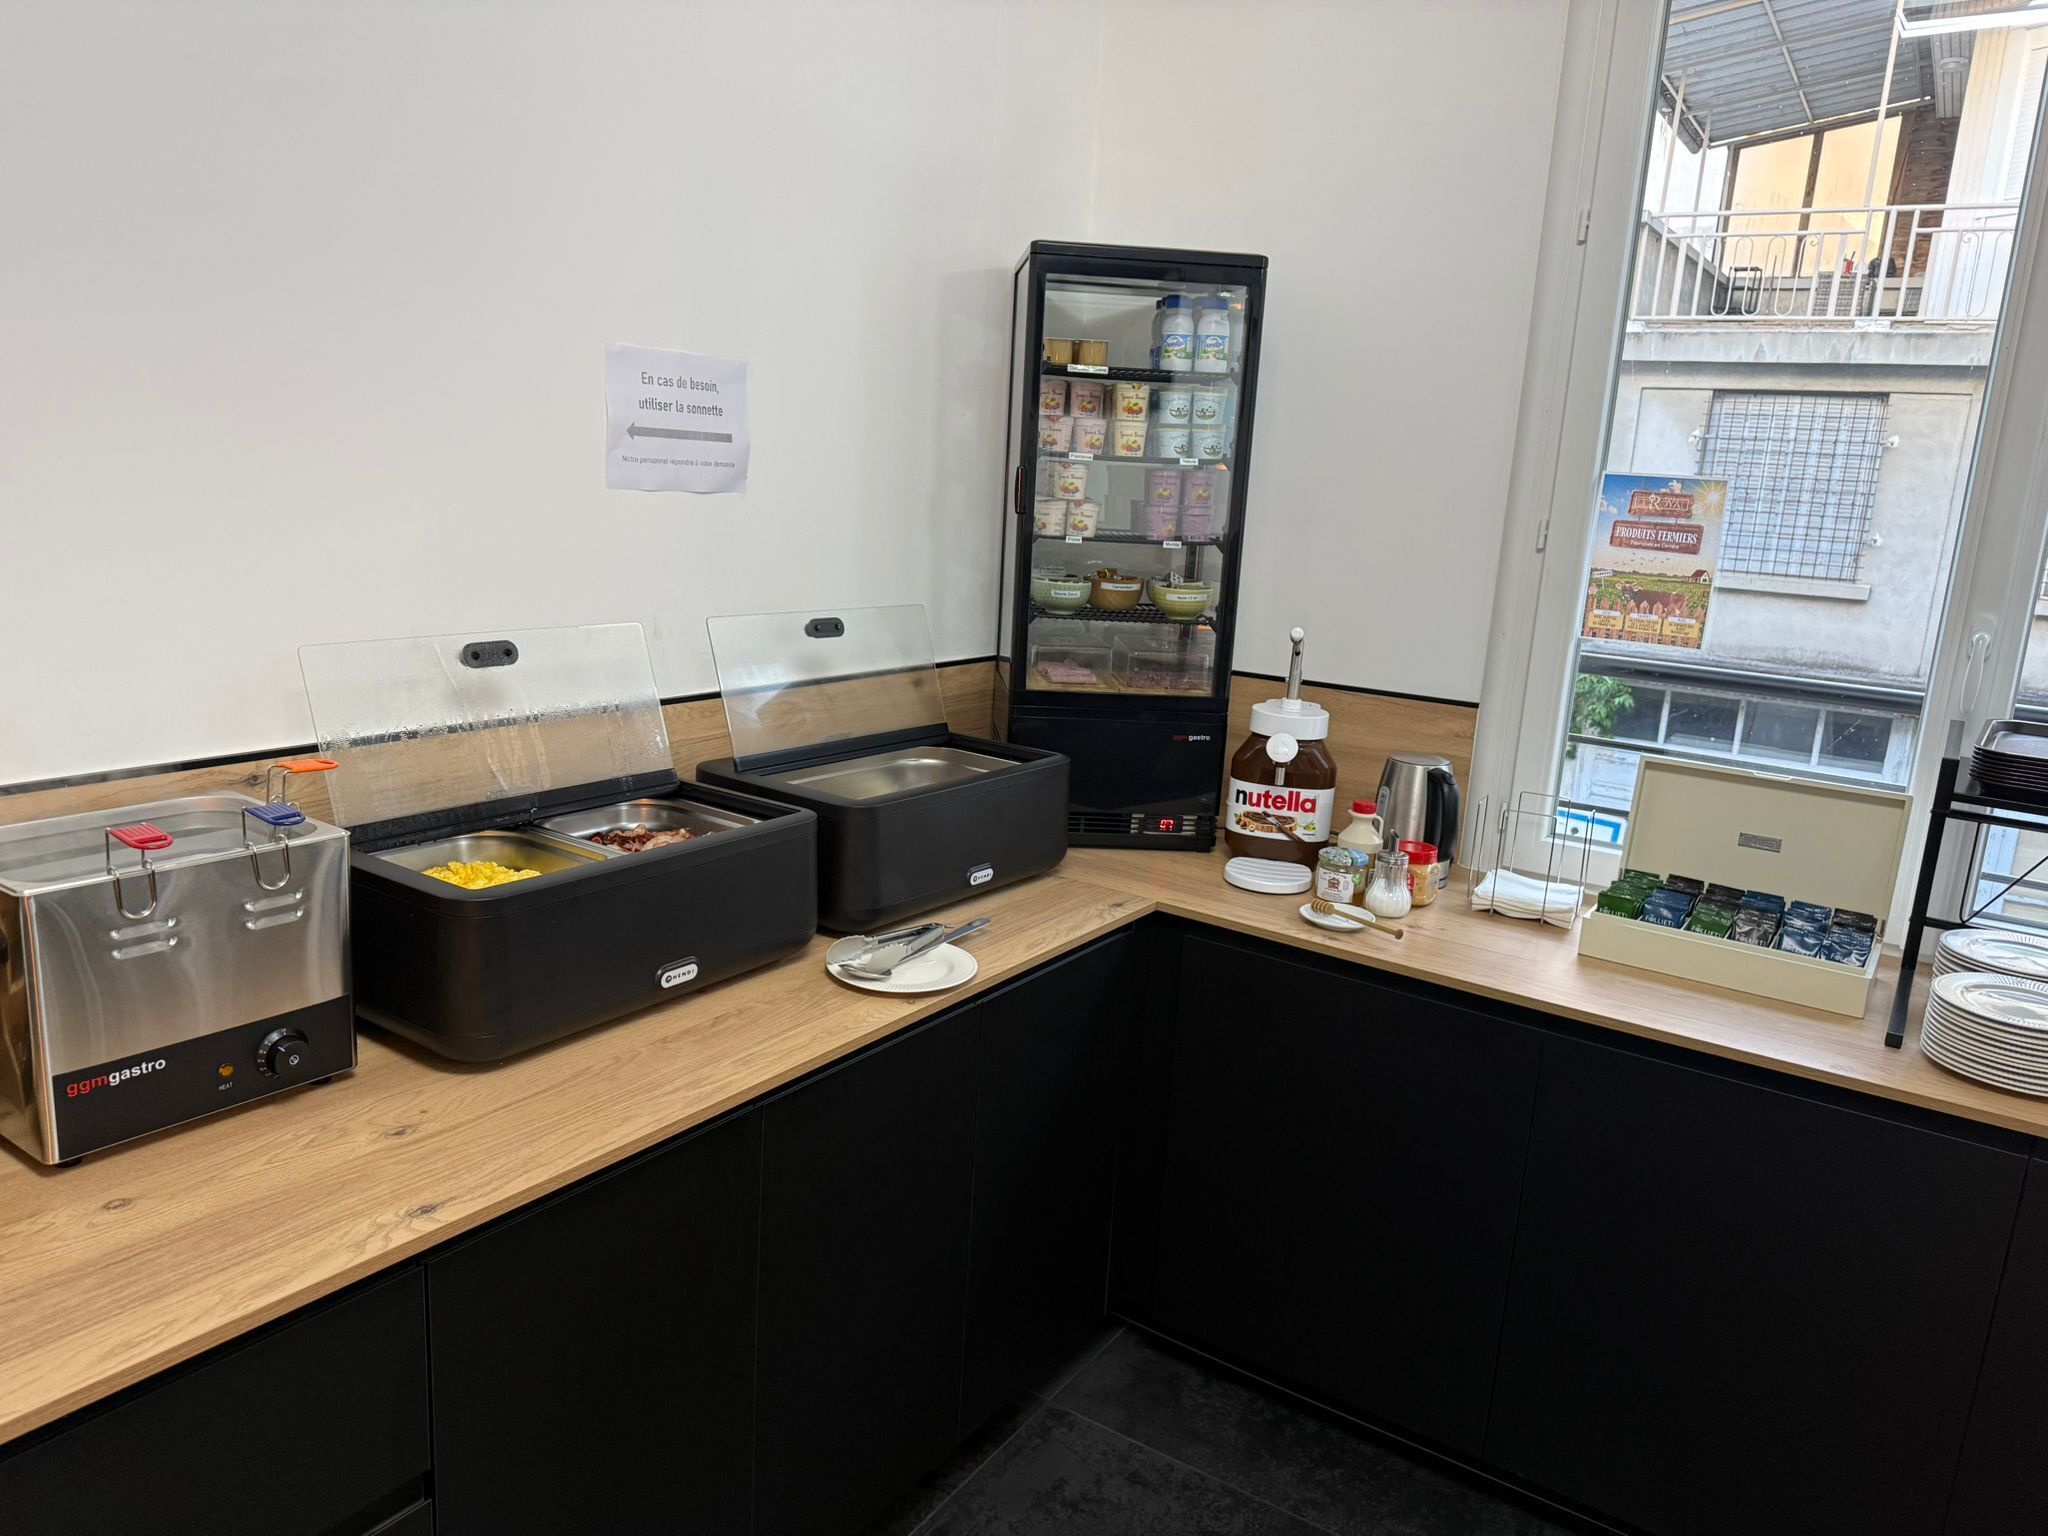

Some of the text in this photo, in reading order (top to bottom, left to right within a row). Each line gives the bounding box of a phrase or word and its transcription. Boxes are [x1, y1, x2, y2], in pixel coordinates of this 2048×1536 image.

[641, 371, 719, 394] En cas de besoin,
[638, 397, 724, 416] utiliser la sonnette
[1615, 526, 1698, 544] PRODUITS FERMIERS
[1235, 788, 1317, 813] nutella
[672, 969, 694, 980] HENDI
[66, 1058, 166, 1097] ggmgastro
[218, 1082, 233, 1091] HEAT
